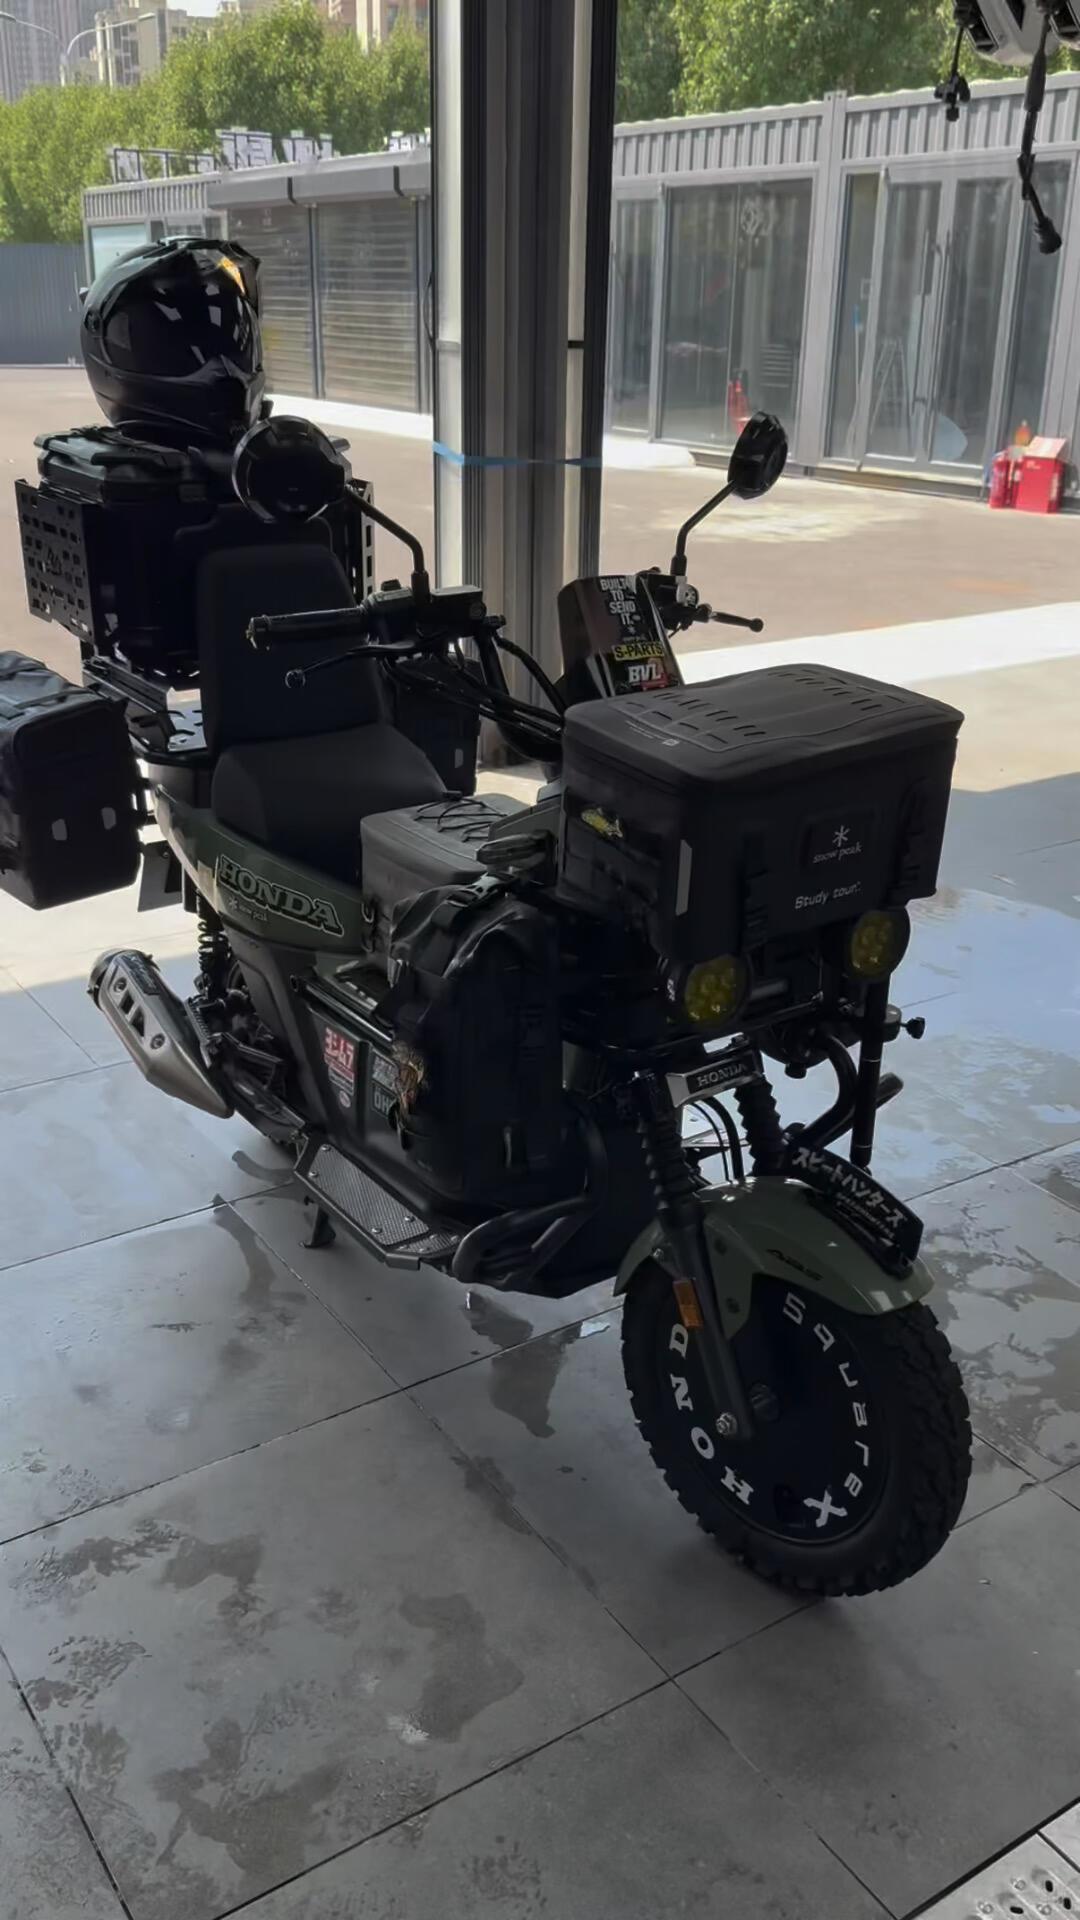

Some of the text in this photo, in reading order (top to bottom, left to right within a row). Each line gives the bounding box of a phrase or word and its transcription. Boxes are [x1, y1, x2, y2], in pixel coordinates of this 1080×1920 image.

[600, 578, 627, 591] BUILT
[610, 590, 624, 601] TO
[609, 602, 636, 614] SEND
[627, 664, 662, 683] BVL
[219, 855, 345, 937] HONDA
[795, 891, 829, 909] Study
[696, 1063, 748, 1087] HONDA
[669, 1322, 754, 1505] HOND
[803, 1489, 848, 1527] X
